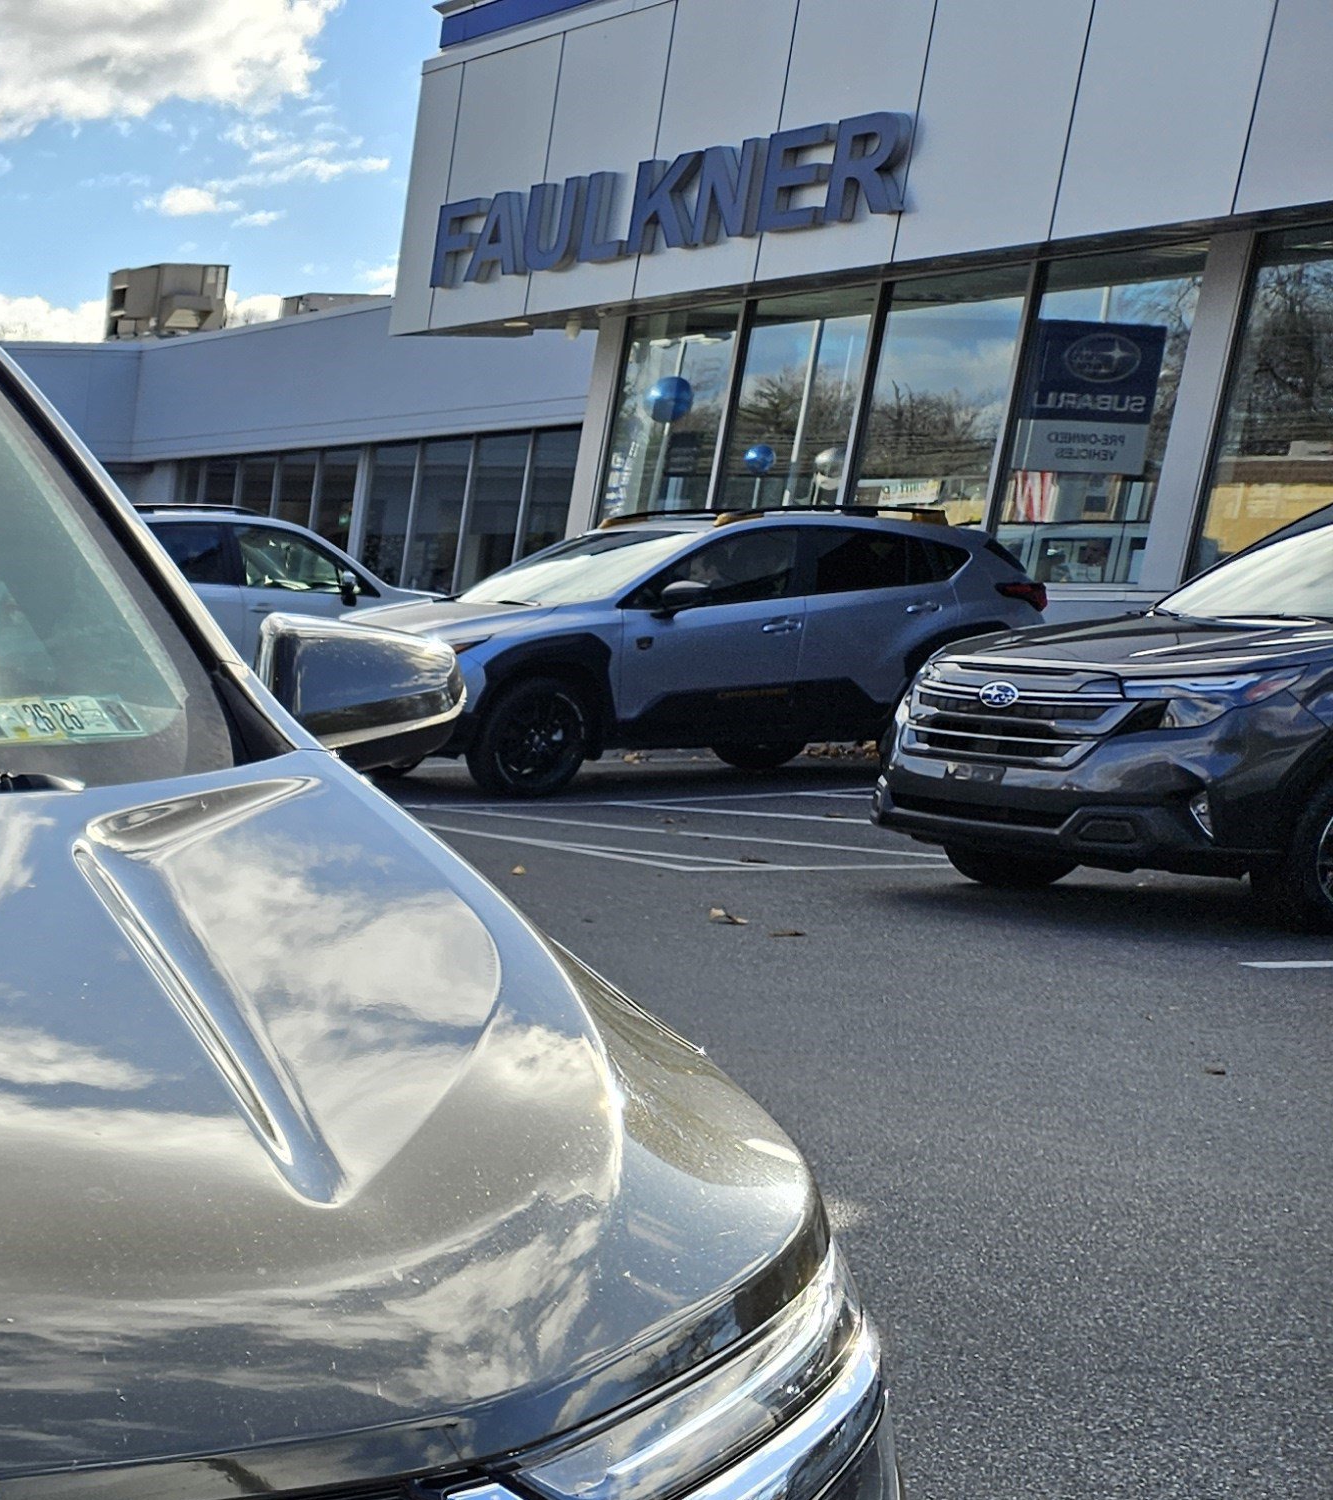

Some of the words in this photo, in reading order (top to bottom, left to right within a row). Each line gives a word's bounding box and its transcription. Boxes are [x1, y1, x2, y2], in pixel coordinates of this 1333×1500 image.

[430, 111, 911, 288] FAULKNER
[22, 703, 56, 733] 26
[49, 702, 85, 731] 26
